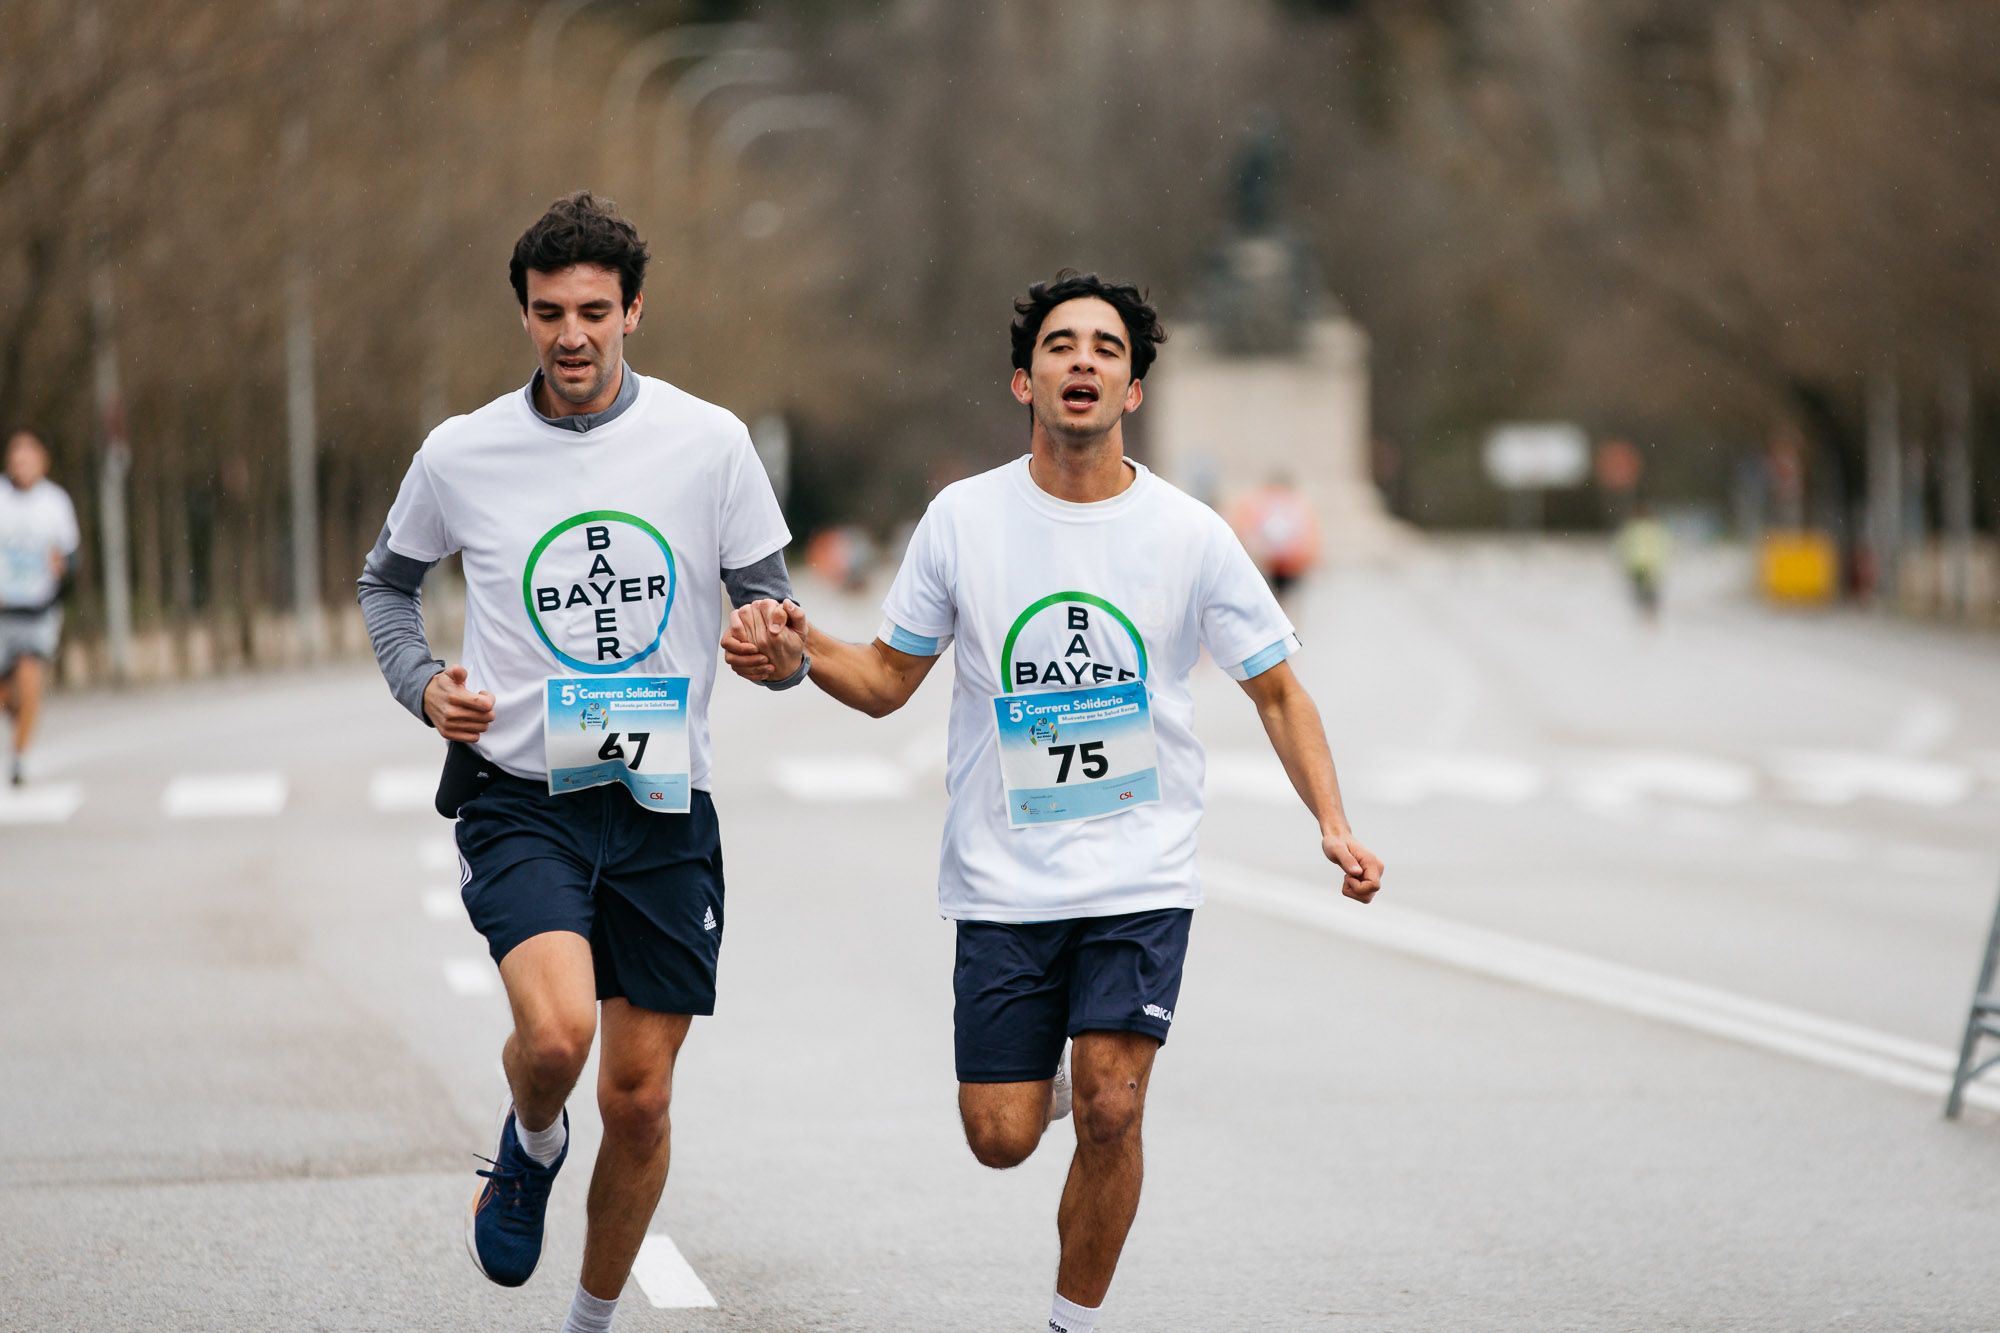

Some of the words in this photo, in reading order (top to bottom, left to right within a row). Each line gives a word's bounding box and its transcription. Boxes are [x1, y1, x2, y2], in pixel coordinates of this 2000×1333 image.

[537, 575, 666, 612] BAYER
[586, 526, 623, 661] BAYER
[1065, 606, 1091, 685] BAY
[579, 688, 623, 700] Carrera
[626, 687, 668, 698] Solidaria
[1026, 703, 1071, 715] Carrera
[1073, 696, 1123, 711] Solidaria
[598, 733, 650, 770] 67
[1048, 740, 1109, 783] 75
[650, 792, 664, 801] CSL
[1119, 790, 1134, 801] CSL
